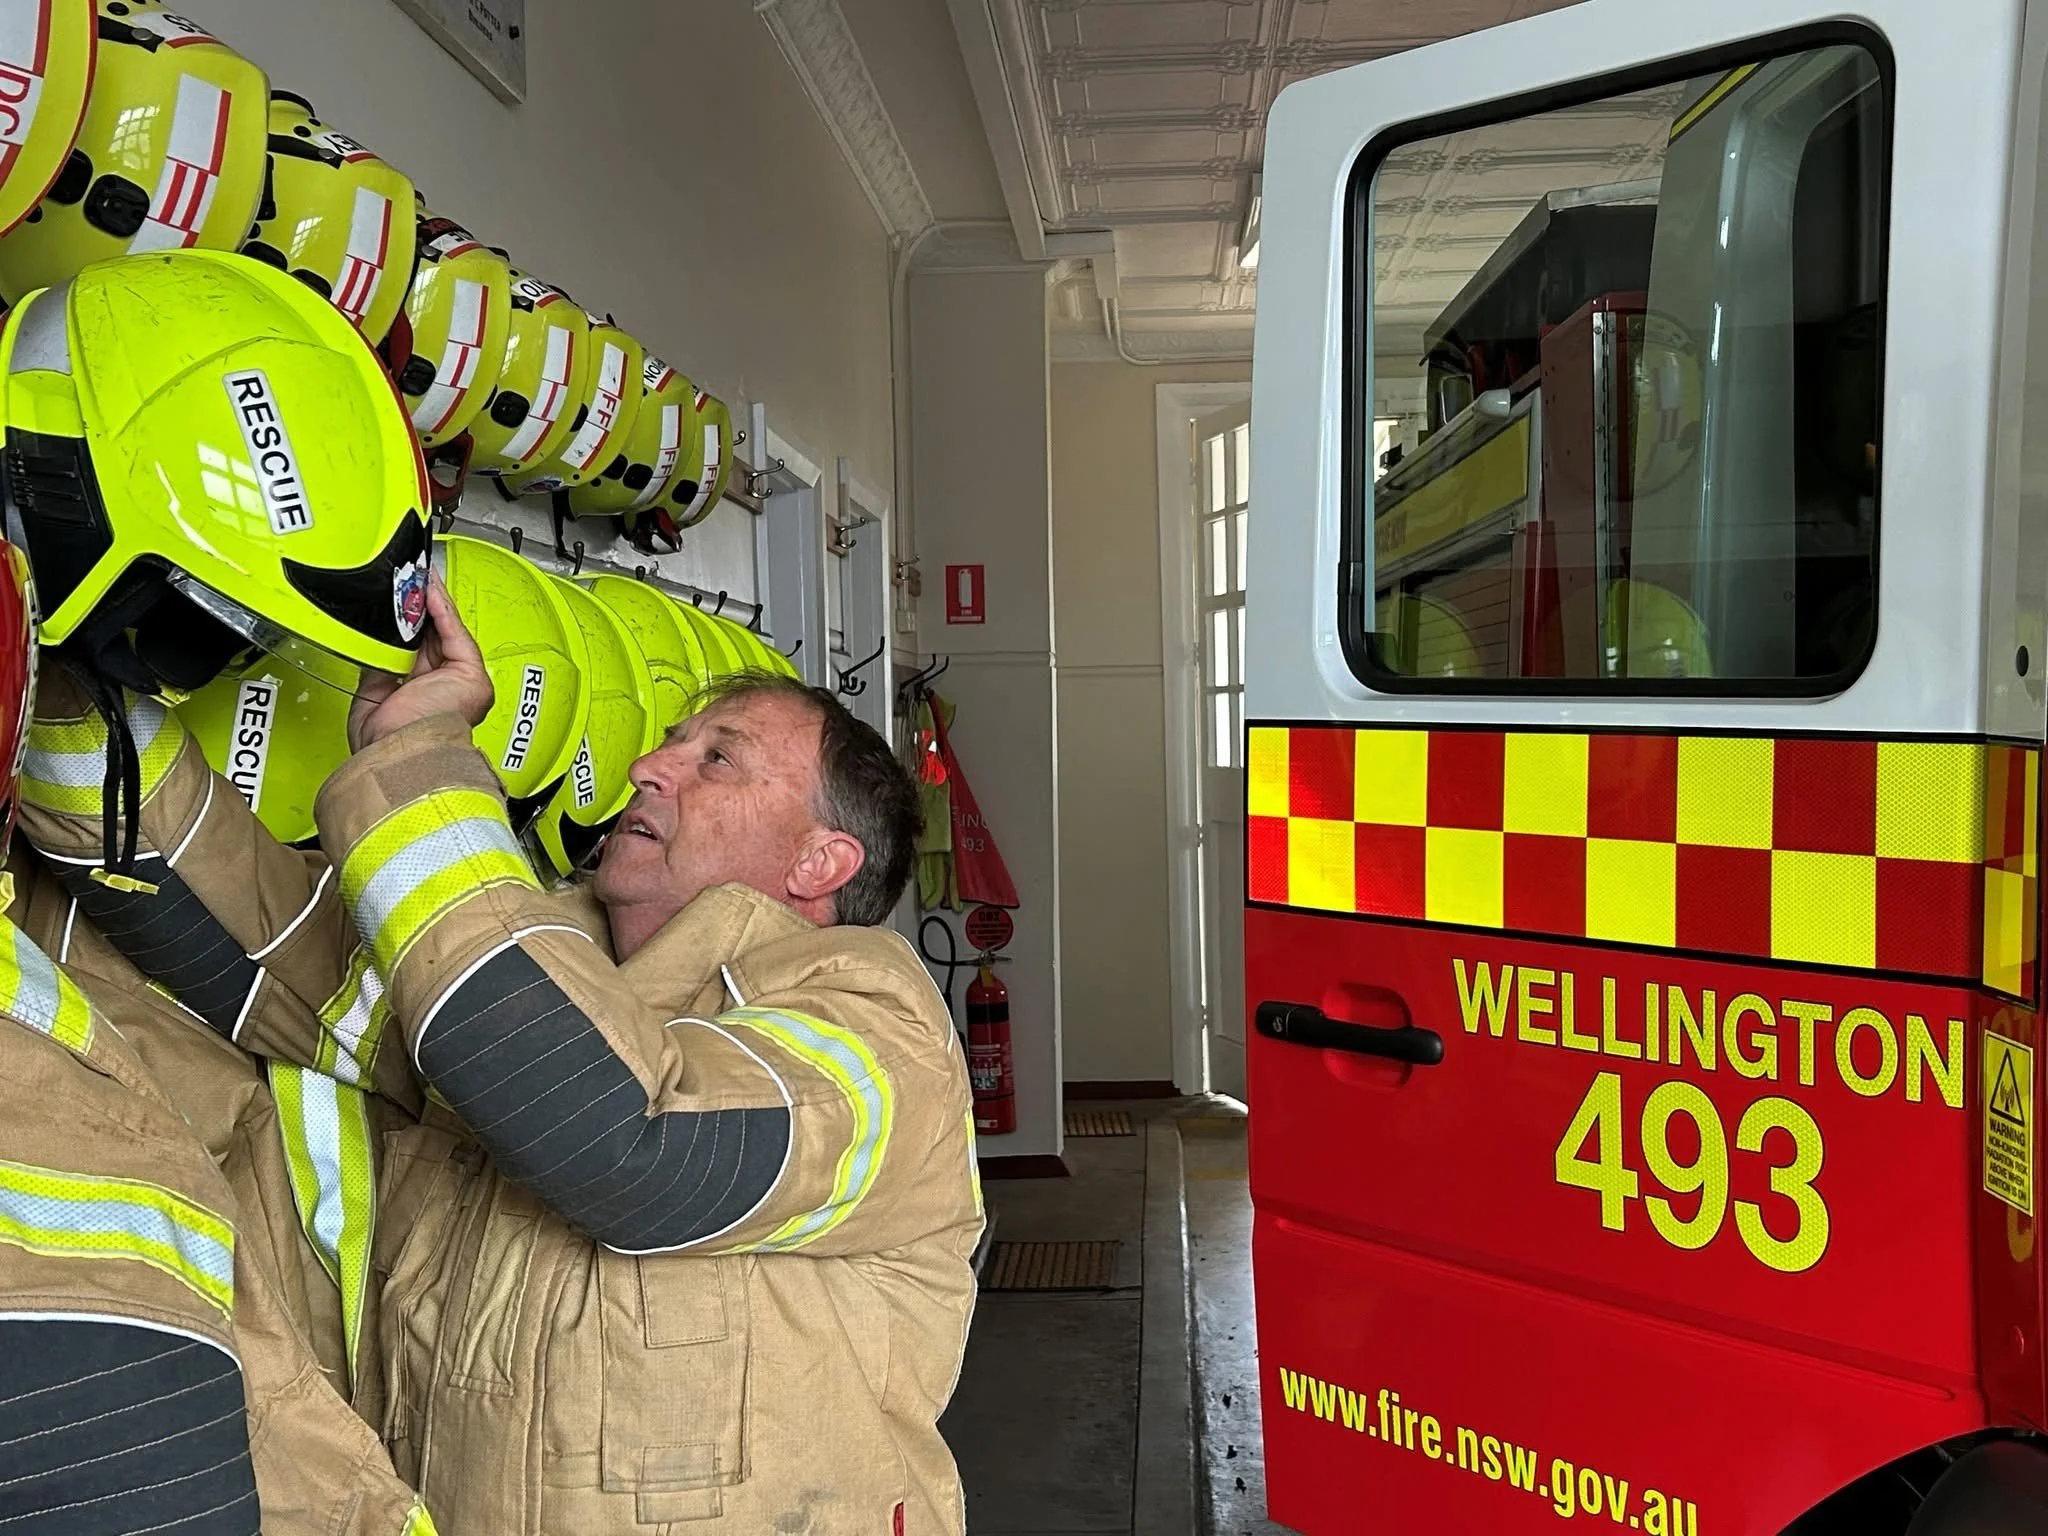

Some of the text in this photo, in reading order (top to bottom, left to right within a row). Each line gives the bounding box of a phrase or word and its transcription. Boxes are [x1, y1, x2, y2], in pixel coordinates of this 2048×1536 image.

[232, 376, 307, 530] RESCUE
[598, 393, 617, 428] FF
[661, 450, 676, 476] FF
[705, 467, 719, 493] FF
[505, 668, 543, 769] RESCUE
[1452, 957, 1965, 1109] WELLINGTON
[1555, 1071, 1830, 1274] 493
[1989, 1118, 2026, 1147] WARNING
[1280, 1367, 1698, 1536] www.fire.nsw.gov.au
